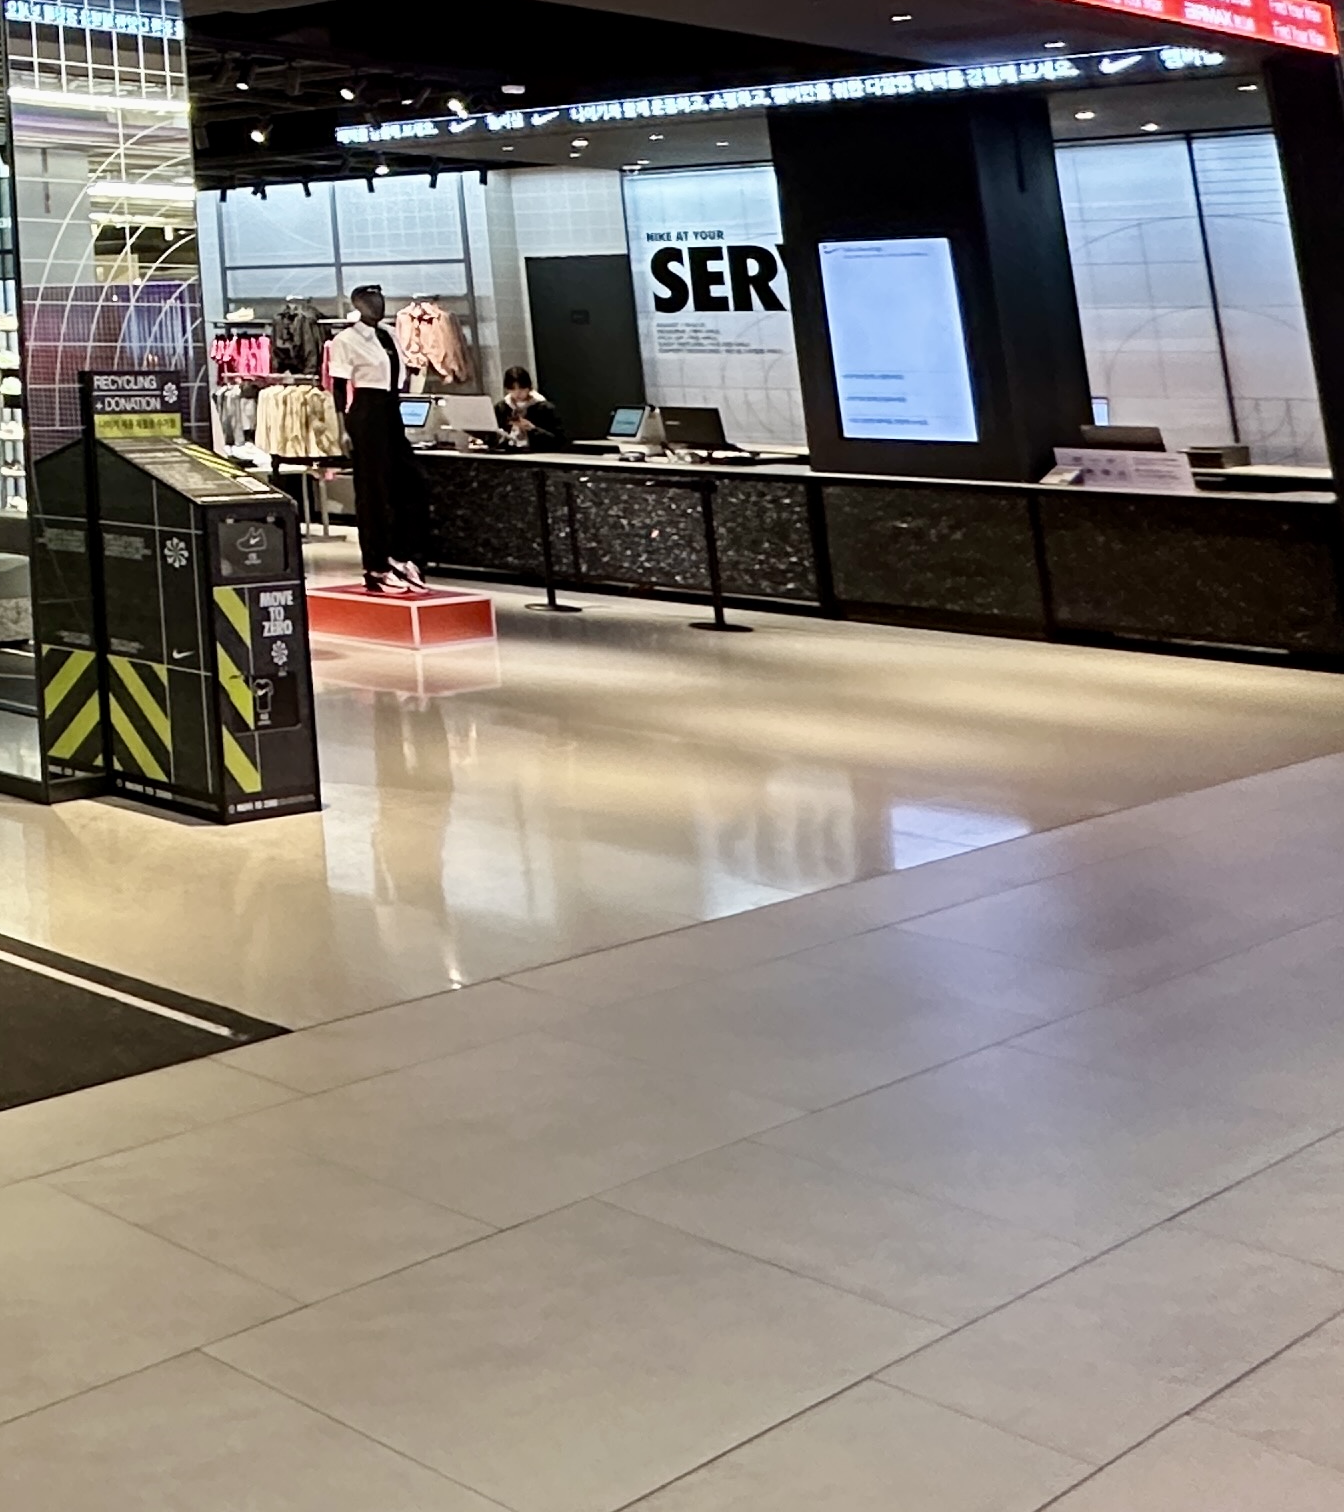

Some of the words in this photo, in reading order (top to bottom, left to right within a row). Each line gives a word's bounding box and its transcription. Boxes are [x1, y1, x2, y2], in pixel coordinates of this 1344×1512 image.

[676, 231, 689, 241] AT
[693, 230, 725, 241] YOUR
[650, 244, 789, 314] SER
[93, 375, 157, 390] RECYCLING
[104, 396, 161, 412] DONATION
[259, 590, 294, 608] MOVE
[268, 606, 285, 621] TO
[262, 620, 294, 638] ZERO
